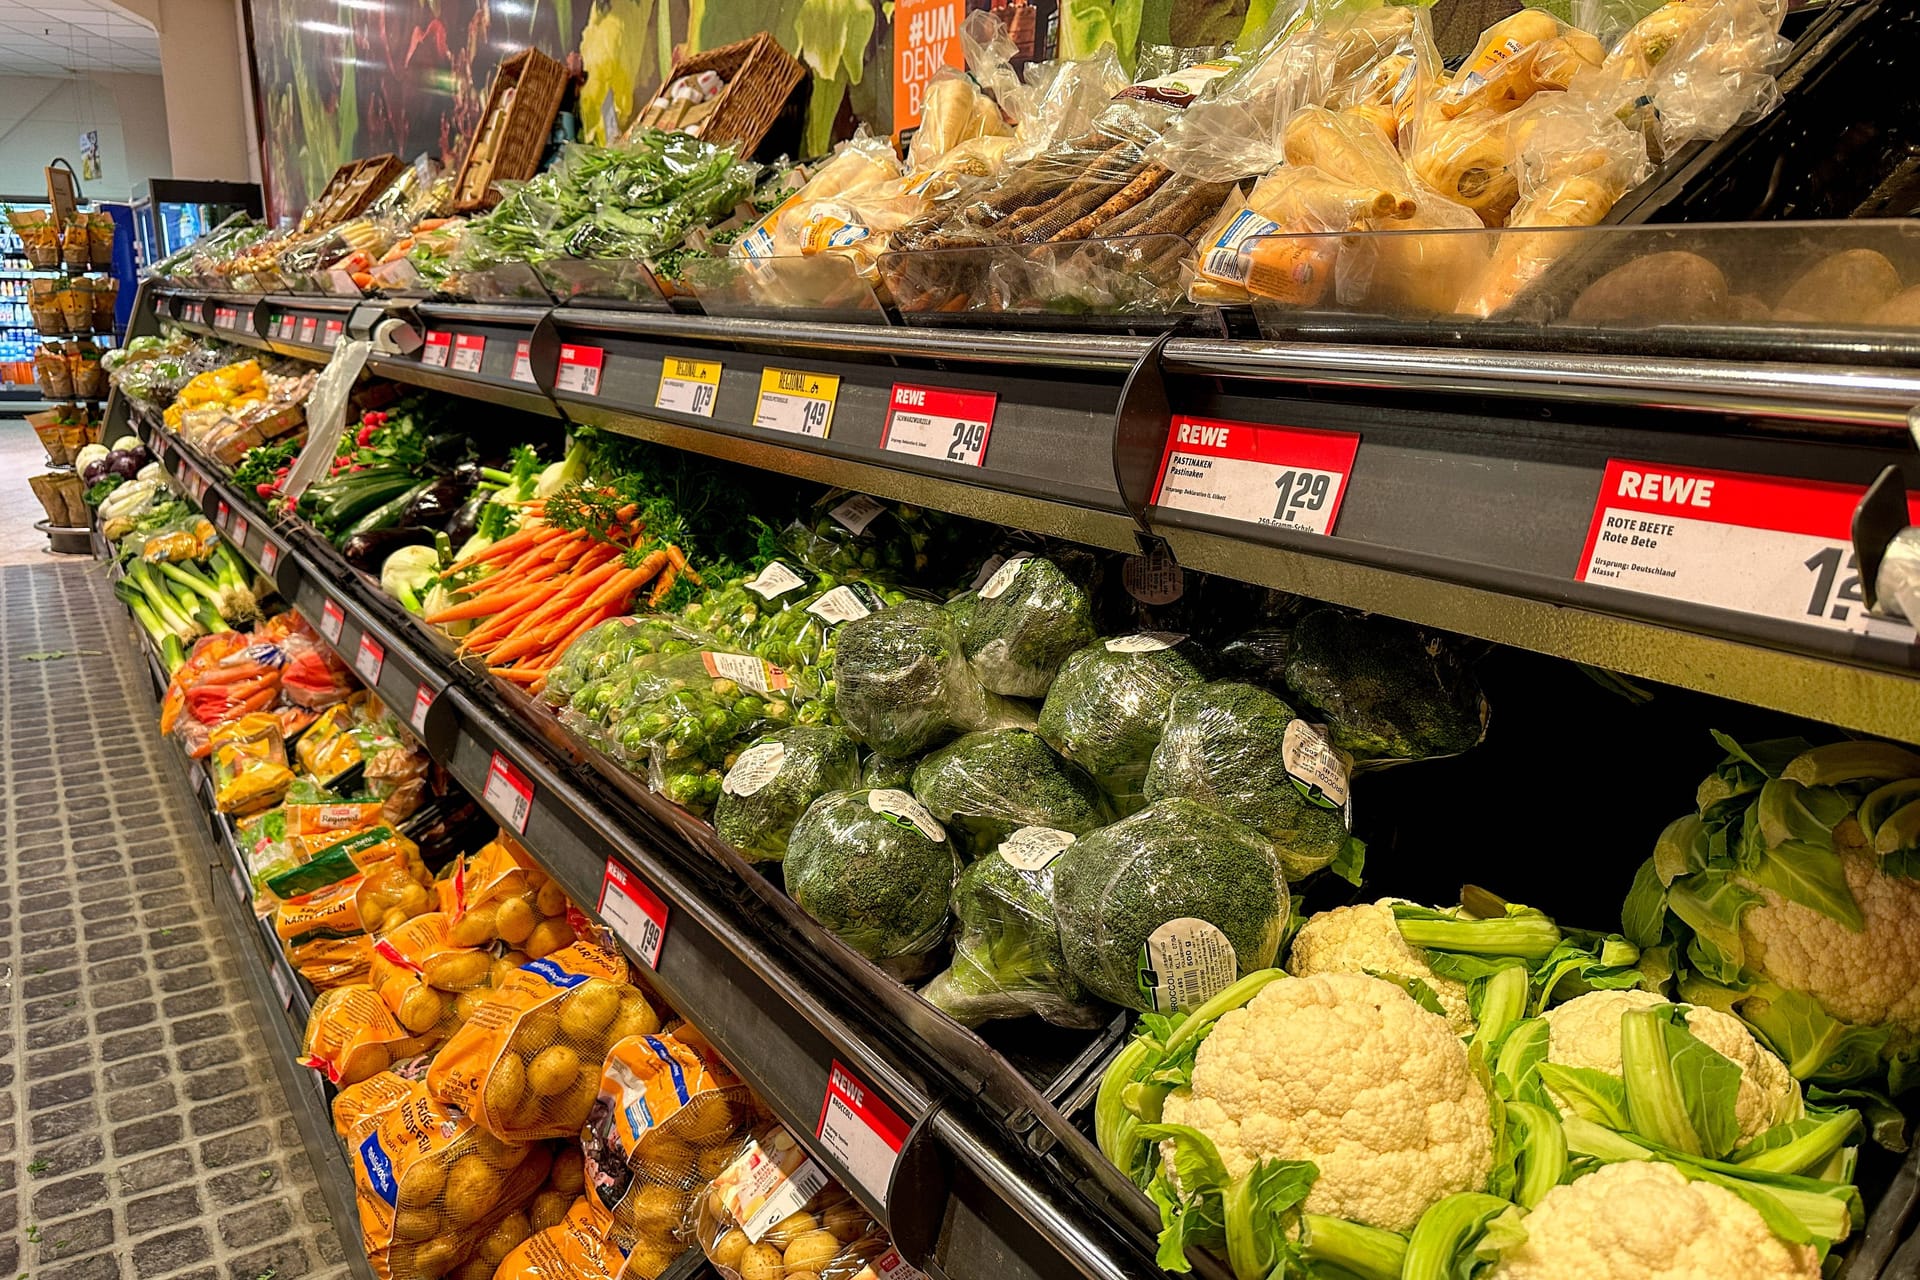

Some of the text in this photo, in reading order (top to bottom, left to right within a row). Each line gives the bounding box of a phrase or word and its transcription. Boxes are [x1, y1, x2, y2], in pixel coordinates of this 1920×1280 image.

[909, 3, 955, 48] #UM
[902, 40, 949, 84] DENK
[692, 385, 713, 413] 0.79
[895, 389, 926, 407] REWE
[802, 401, 826, 433] 1.49
[947, 422, 985, 461] 2.49
[1177, 423, 1230, 449] REWE
[1170, 466, 1204, 478] Pastinaken
[1173, 456, 1213, 469] PASTINAKEN
[1273, 470, 1331, 522] 1.29
[1617, 470, 1715, 508] REWE
[1602, 530, 1657, 549] Rote Bete
[1606, 516, 1675, 536] ROTE BEETE
[1592, 567, 1615, 577] Klasse
[1595, 557, 1677, 578] Ursprung: Deutschland
[1315, 770, 1344, 795] BROCCOLI
[608, 861, 628, 886] REWE
[641, 918, 660, 953] 1.99
[1166, 970, 1179, 1012] BROCCOLI
[832, 1068, 864, 1109] REWE
[416, 1097, 435, 1131] SPEISE-
[832, 1097, 854, 1121] BROCCOLI
[401, 1100, 433, 1154] KARTOFFELN
